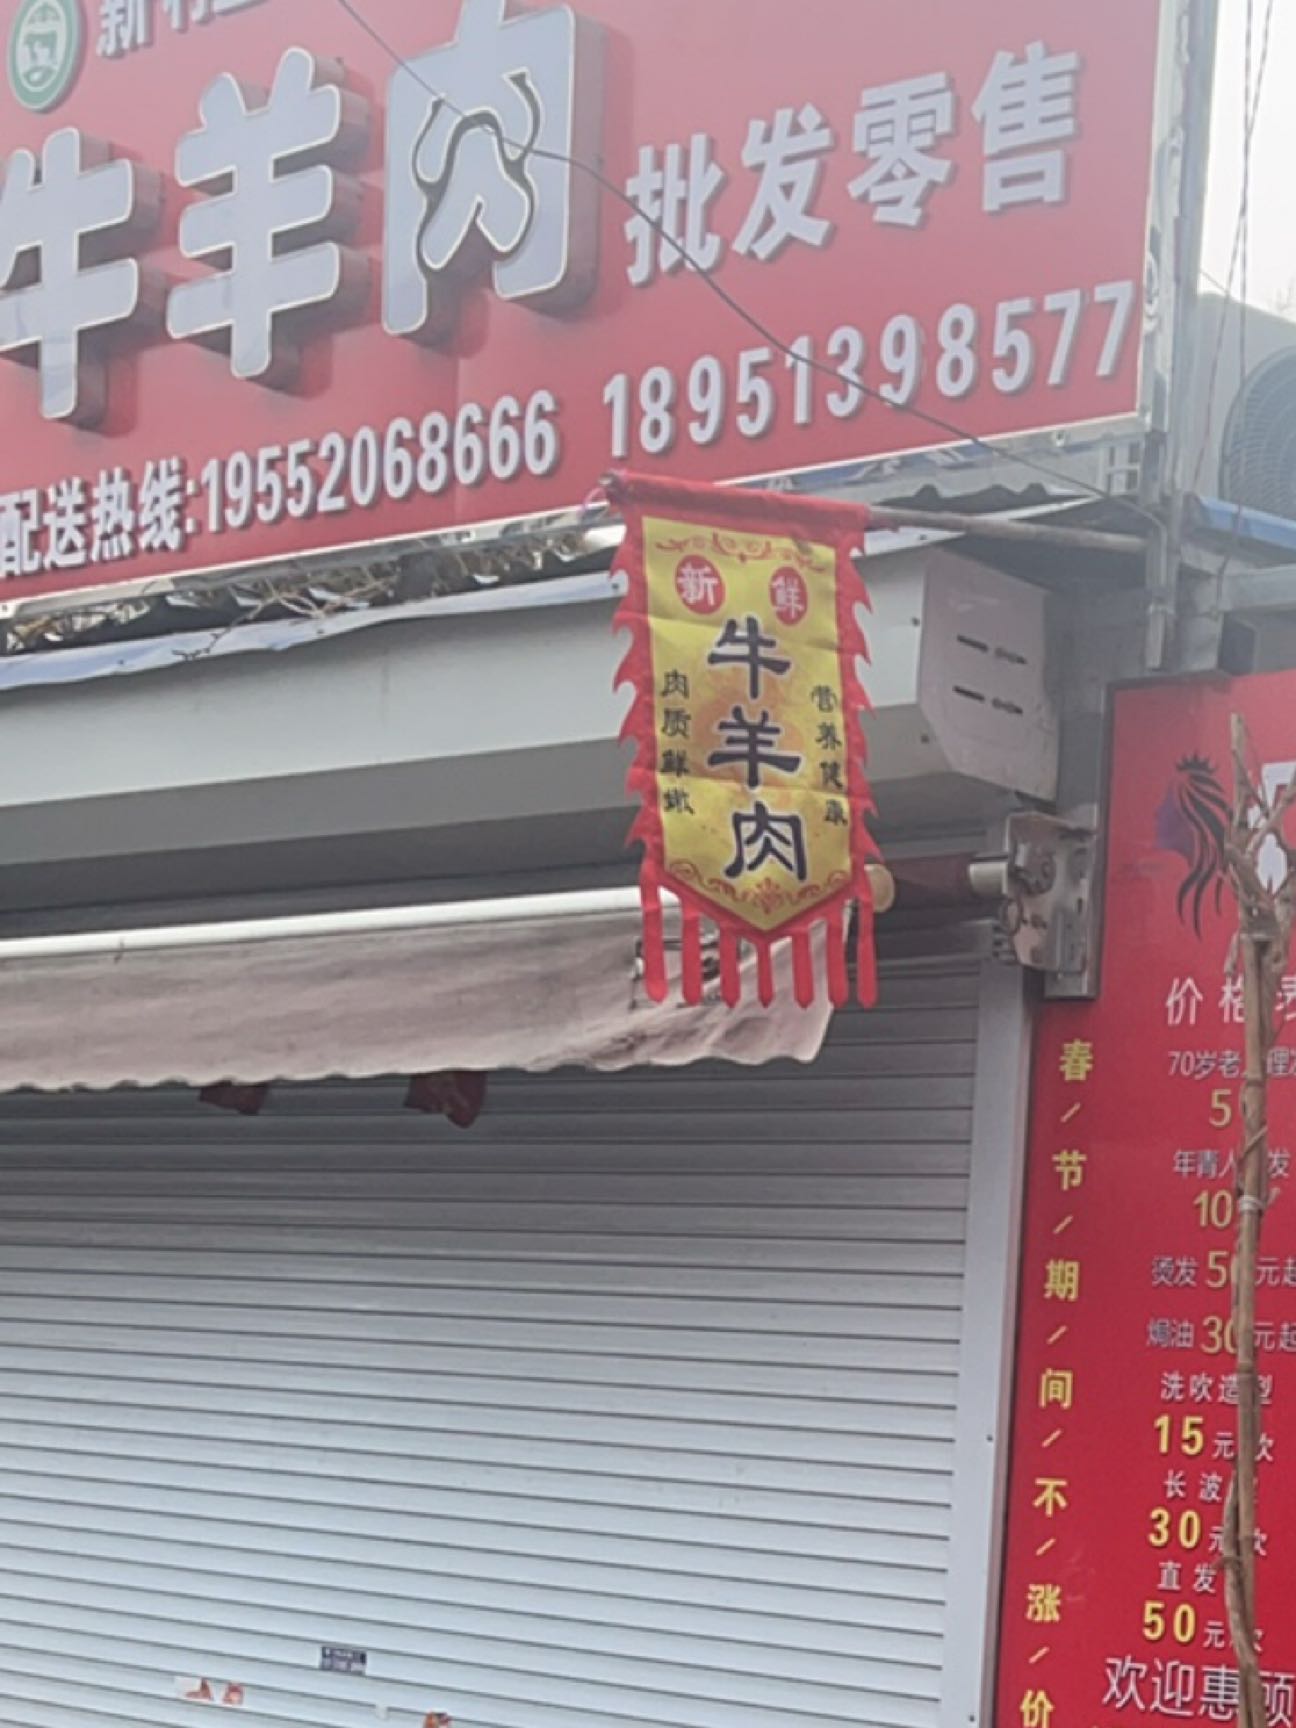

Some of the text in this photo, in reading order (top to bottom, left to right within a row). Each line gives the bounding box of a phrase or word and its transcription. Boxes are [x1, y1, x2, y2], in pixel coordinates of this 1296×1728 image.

[0, 0, 578, 419] 牛羊肉
[623, 40, 1081, 286] 批发零售
[603, 280, 1134, 458] 18951398577
[707, 616, 803, 881] 牛羊肉
